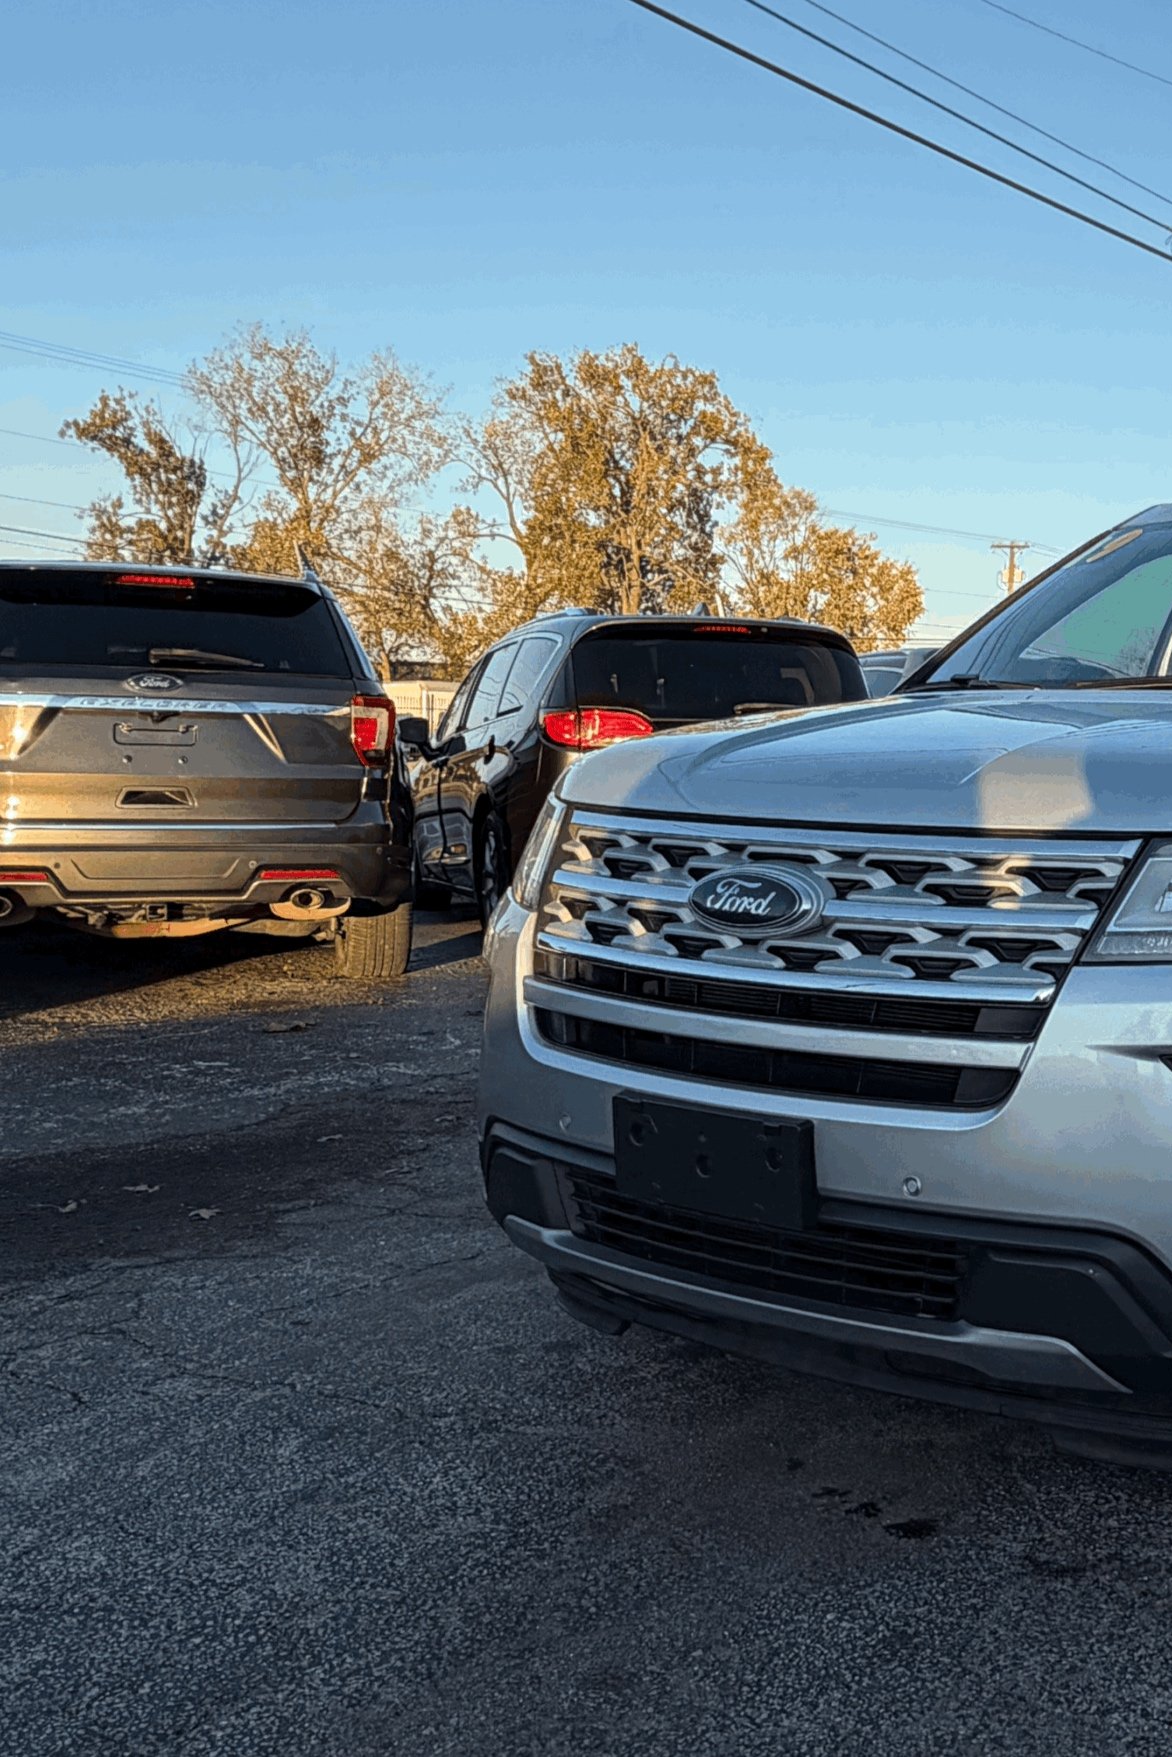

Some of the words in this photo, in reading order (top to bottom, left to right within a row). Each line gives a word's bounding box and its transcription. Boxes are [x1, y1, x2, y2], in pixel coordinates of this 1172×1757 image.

[139, 676, 169, 689] Ford
[80, 698, 228, 711] EXPLORER
[706, 878, 776, 916] Ford
